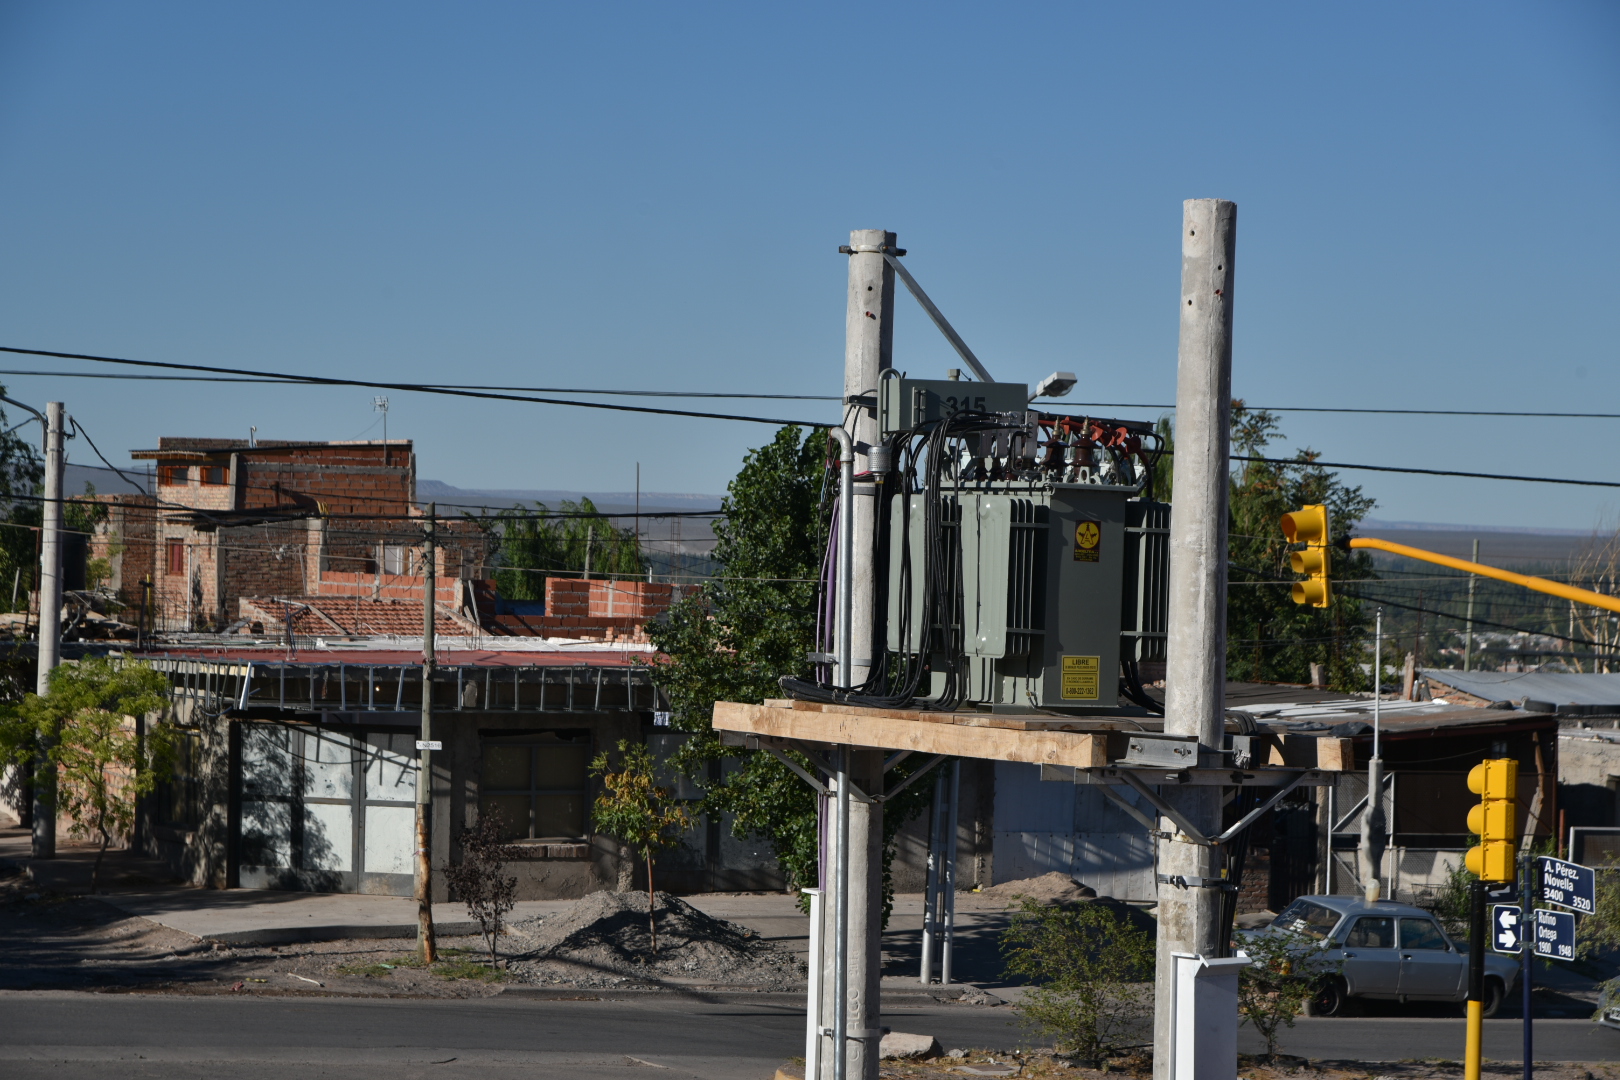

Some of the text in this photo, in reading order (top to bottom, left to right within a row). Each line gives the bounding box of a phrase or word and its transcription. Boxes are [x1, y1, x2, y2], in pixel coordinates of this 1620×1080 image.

[946, 396, 986, 417] 315
[1544, 860, 1579, 879] A. Pérez.
[1544, 873, 1574, 892] Novella
[1543, 888, 1591, 910] 3400 3520
[1538, 911, 1556, 926] Rufino
[1538, 926, 1557, 942] Ortega
[1539, 942, 1572, 957] 1900 1948
